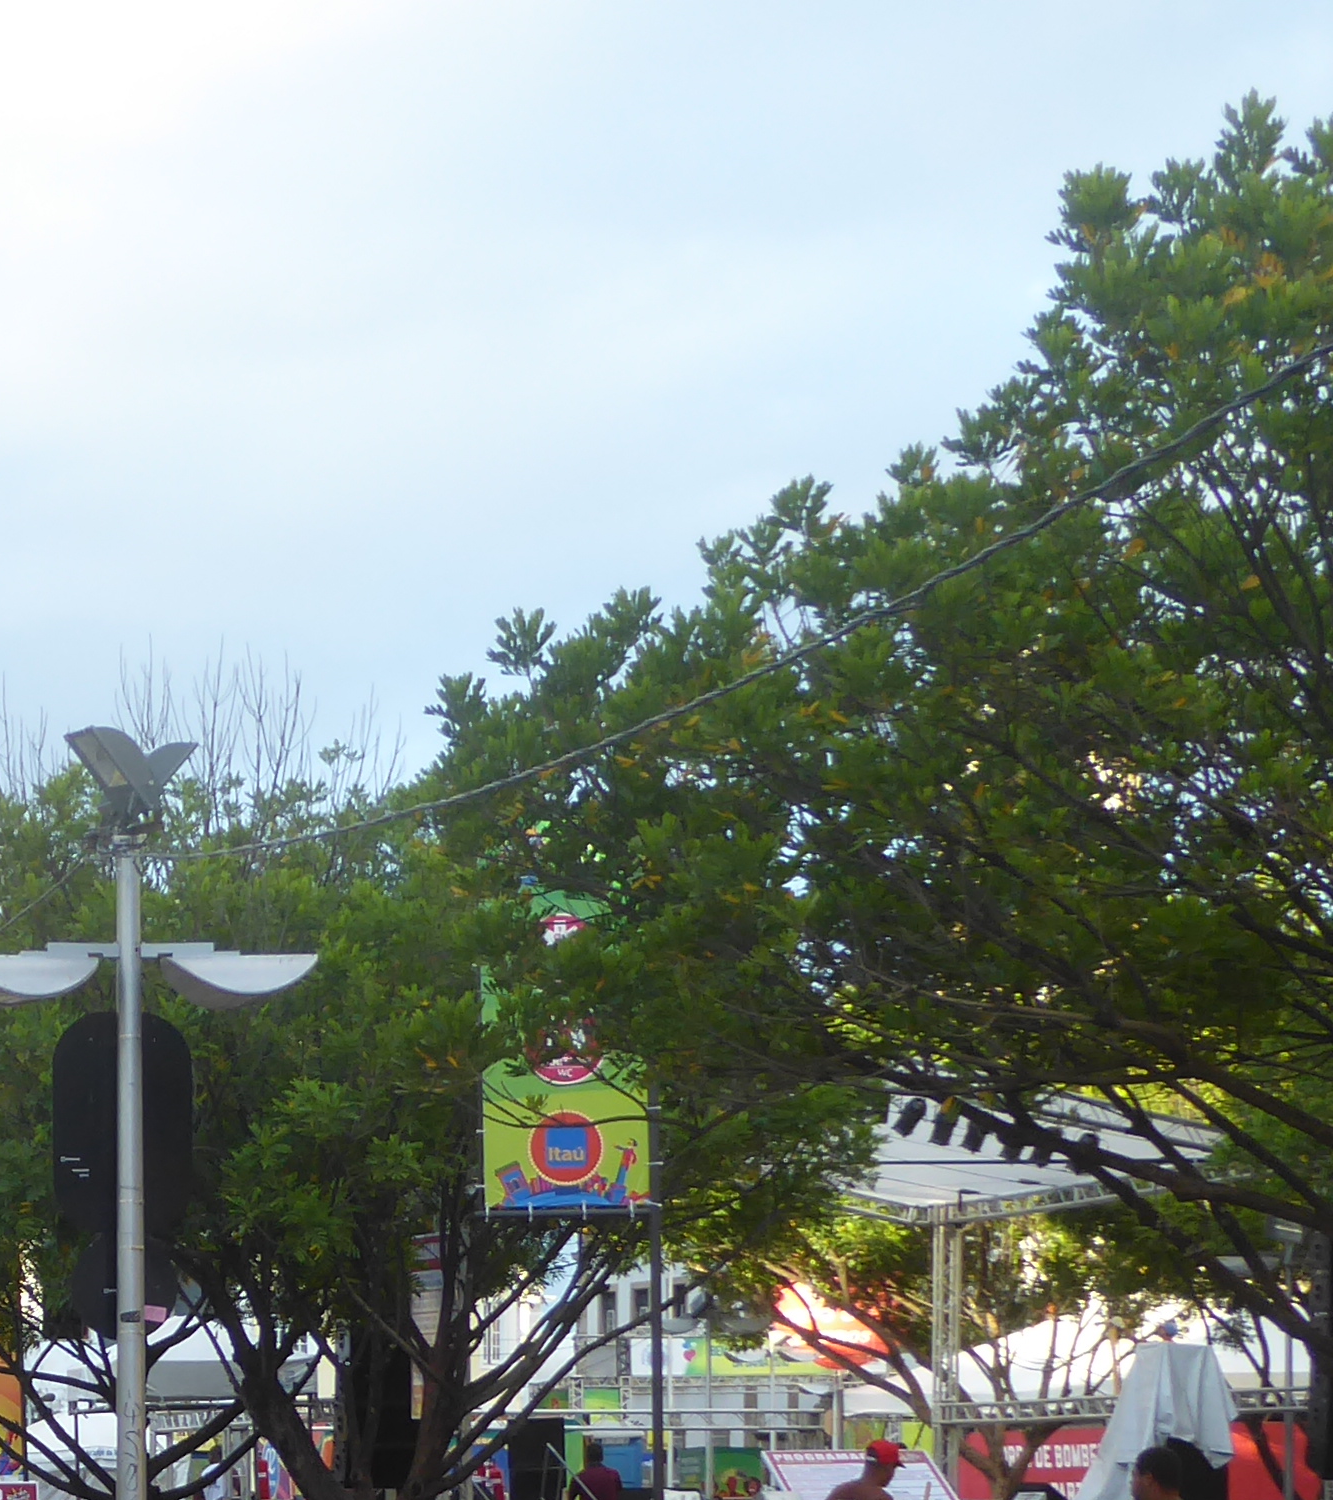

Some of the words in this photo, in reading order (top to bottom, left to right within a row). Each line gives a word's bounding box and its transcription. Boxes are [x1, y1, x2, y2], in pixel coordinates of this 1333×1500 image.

[557, 1067, 573, 1078] WC
[548, 1146, 585, 1162] Itaú
[773, 1452, 865, 1462] PROGRAMA
[1054, 1443, 1100, 1468] BOMBE
